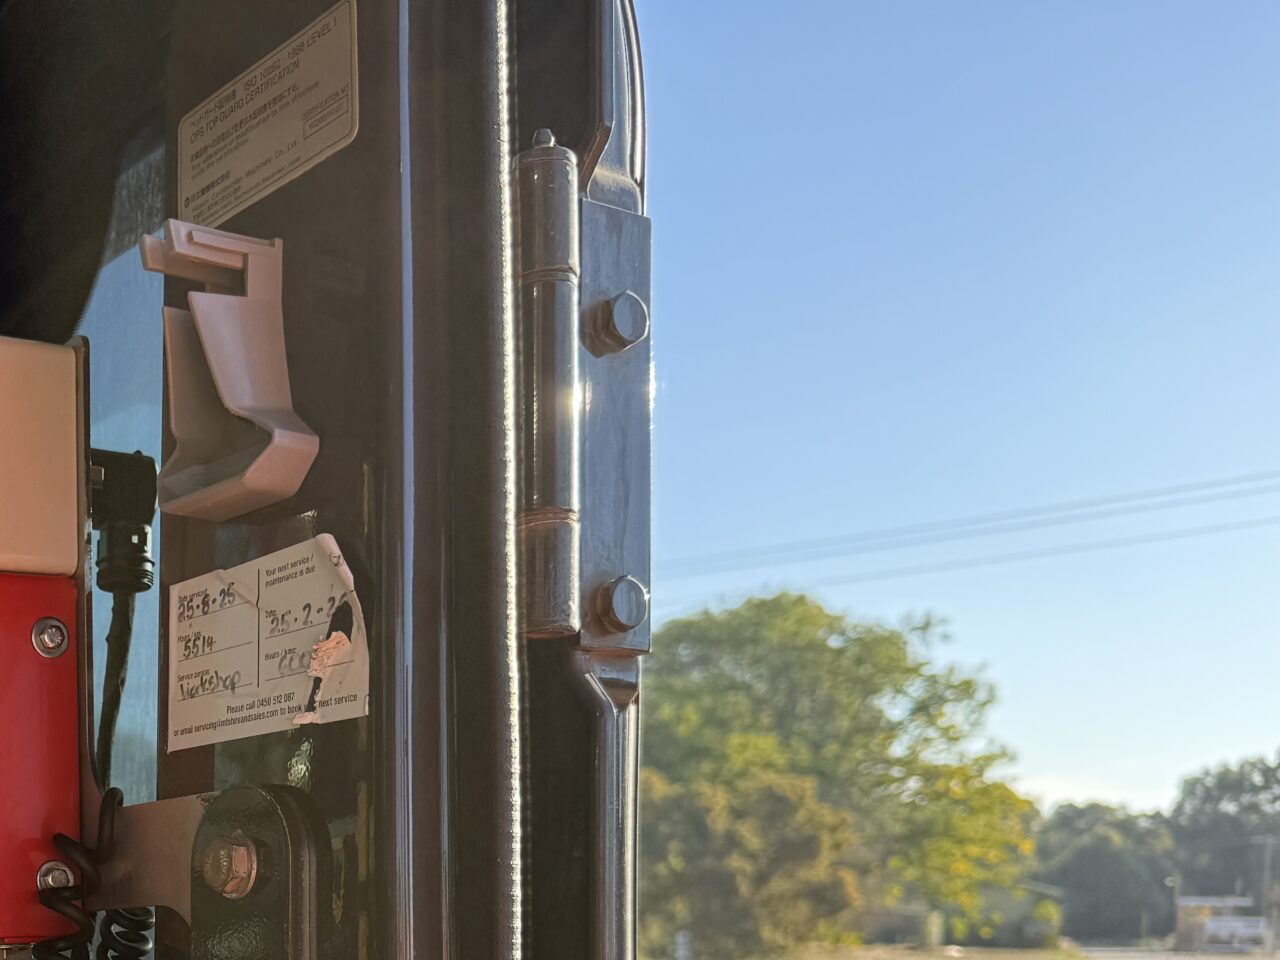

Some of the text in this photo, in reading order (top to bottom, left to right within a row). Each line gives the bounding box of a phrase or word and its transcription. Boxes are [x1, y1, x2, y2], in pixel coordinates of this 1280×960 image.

[244, 75, 257, 91] ISO
[306, 23, 332, 48] LEVEL
[220, 99, 244, 123] GUARD
[245, 59, 300, 105] CERTIFICATION
[265, 567, 277, 577] Your
[277, 562, 289, 574] next
[290, 556, 310, 569] service
[265, 571, 298, 588] maintenance
[265, 651, 280, 661] Hours
[177, 672, 194, 682] Service
[226, 692, 295, 714] Please call 0450 512 087
[173, 729, 179, 737] or
[180, 724, 194, 736] email
[280, 707, 286, 715] to
[287, 703, 302, 715] book
[318, 697, 333, 709] next
[334, 693, 358, 705] service
